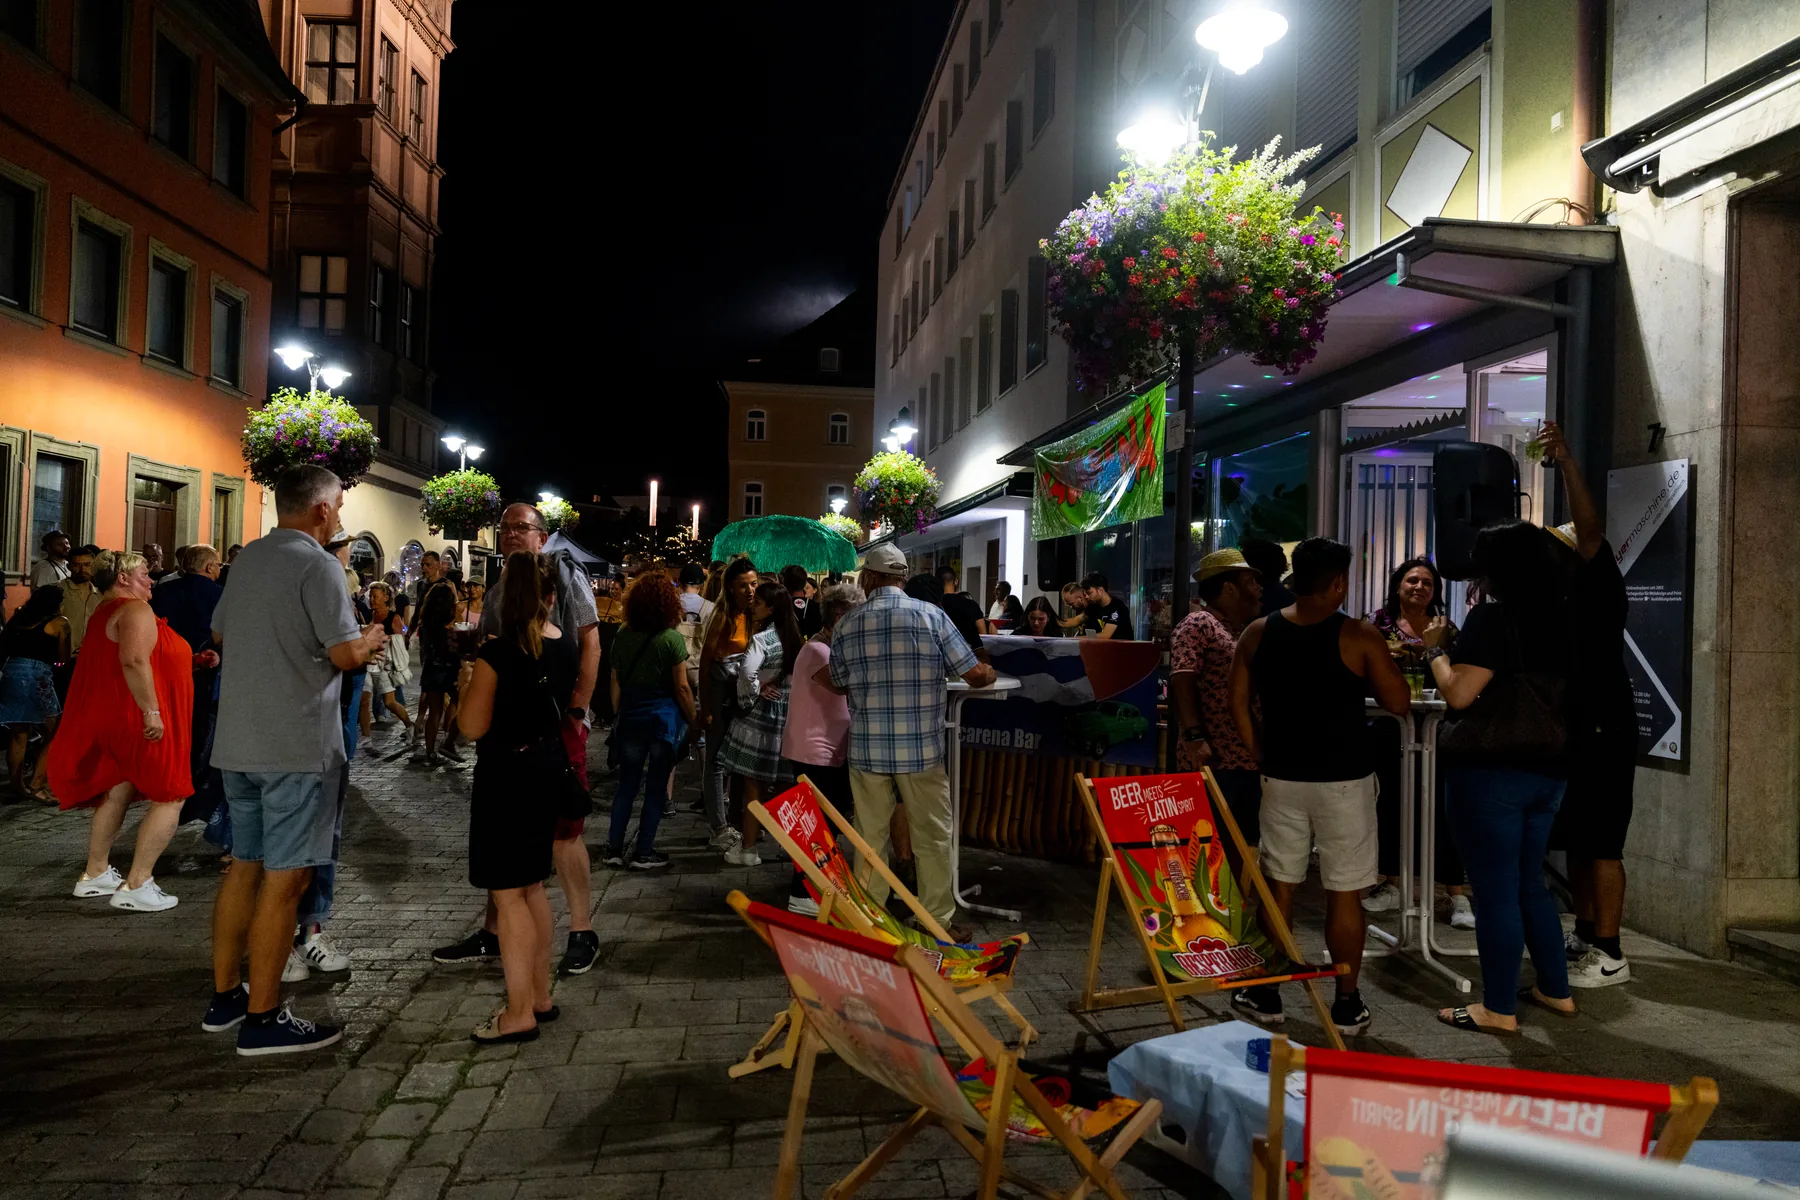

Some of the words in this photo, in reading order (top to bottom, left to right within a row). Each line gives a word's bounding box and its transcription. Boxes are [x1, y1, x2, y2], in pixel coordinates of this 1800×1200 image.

[1648, 422, 1662, 453] 7
[1615, 470, 1680, 565] yermaschine.de
[958, 726, 1011, 747] carena
[1013, 727, 1042, 750] Bar
[1110, 782, 1144, 810] BEER
[1142, 785, 1164, 802] MEETS
[1146, 796, 1179, 823] LATIN
[1177, 797, 1196, 815] SPIRIT
[1174, 945, 1264, 977] DESPERADOS
